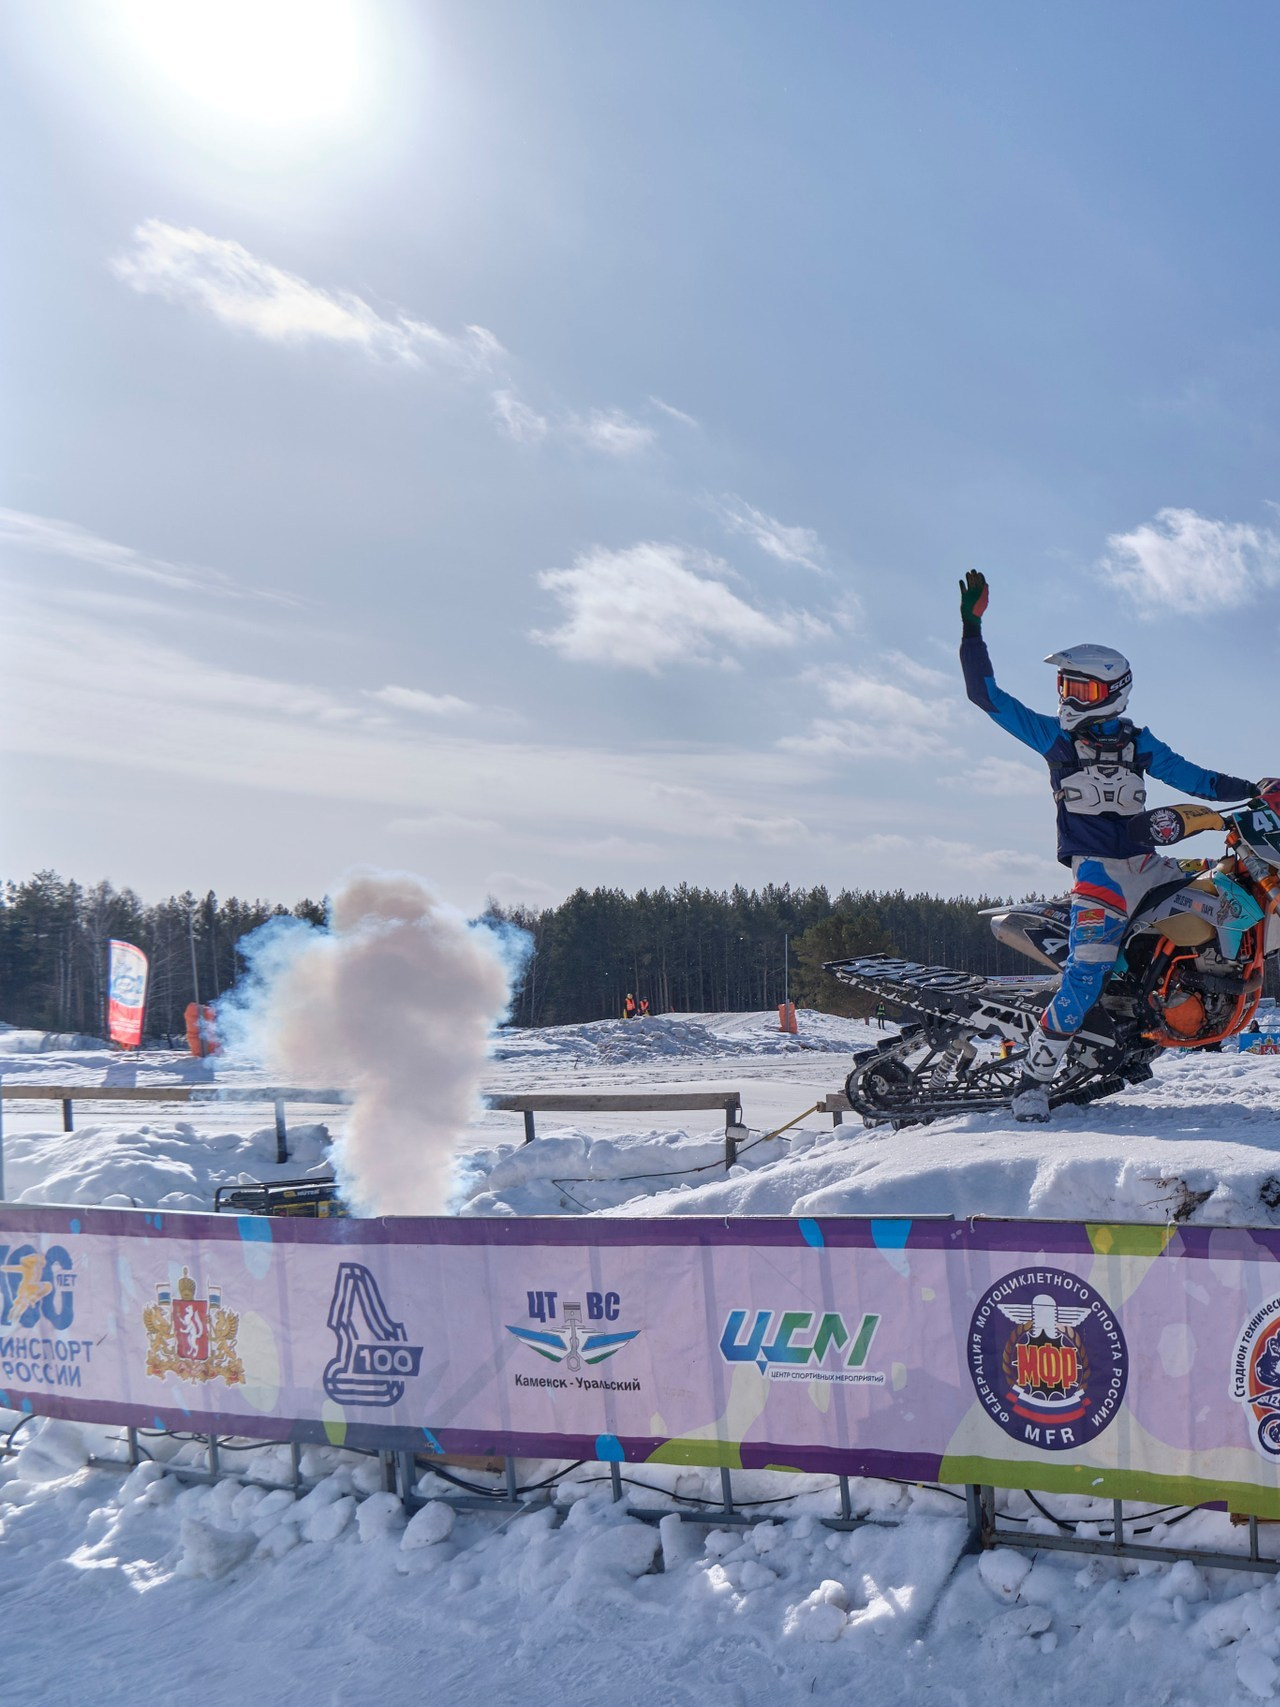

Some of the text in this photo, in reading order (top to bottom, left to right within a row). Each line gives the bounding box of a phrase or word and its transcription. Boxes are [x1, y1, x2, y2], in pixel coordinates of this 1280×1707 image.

[56, 1274, 77, 1287] ЛЕТ
[527, 1291, 620, 1323] ЦТ ВС
[360, 1348, 413, 1373] 100
[973, 1272, 1123, 1426] ФЕДЕРАЦИЯ МОТОЦИКЛЕТНОГО СПОРТА РОССИИ
[2, 1361, 82, 1388] РОССИИ
[771, 1371, 884, 1383] ЦЕНТР СПОРТИВНЫХ МЕРОПРИЯТИЙ
[1016, 1343, 1078, 1389] МФР
[1234, 1345, 1248, 1397] Стадион
[515, 1374, 567, 1389] Каменск
[575, 1377, 641, 1391] Уральский
[1025, 1424, 1075, 1444] MFR
